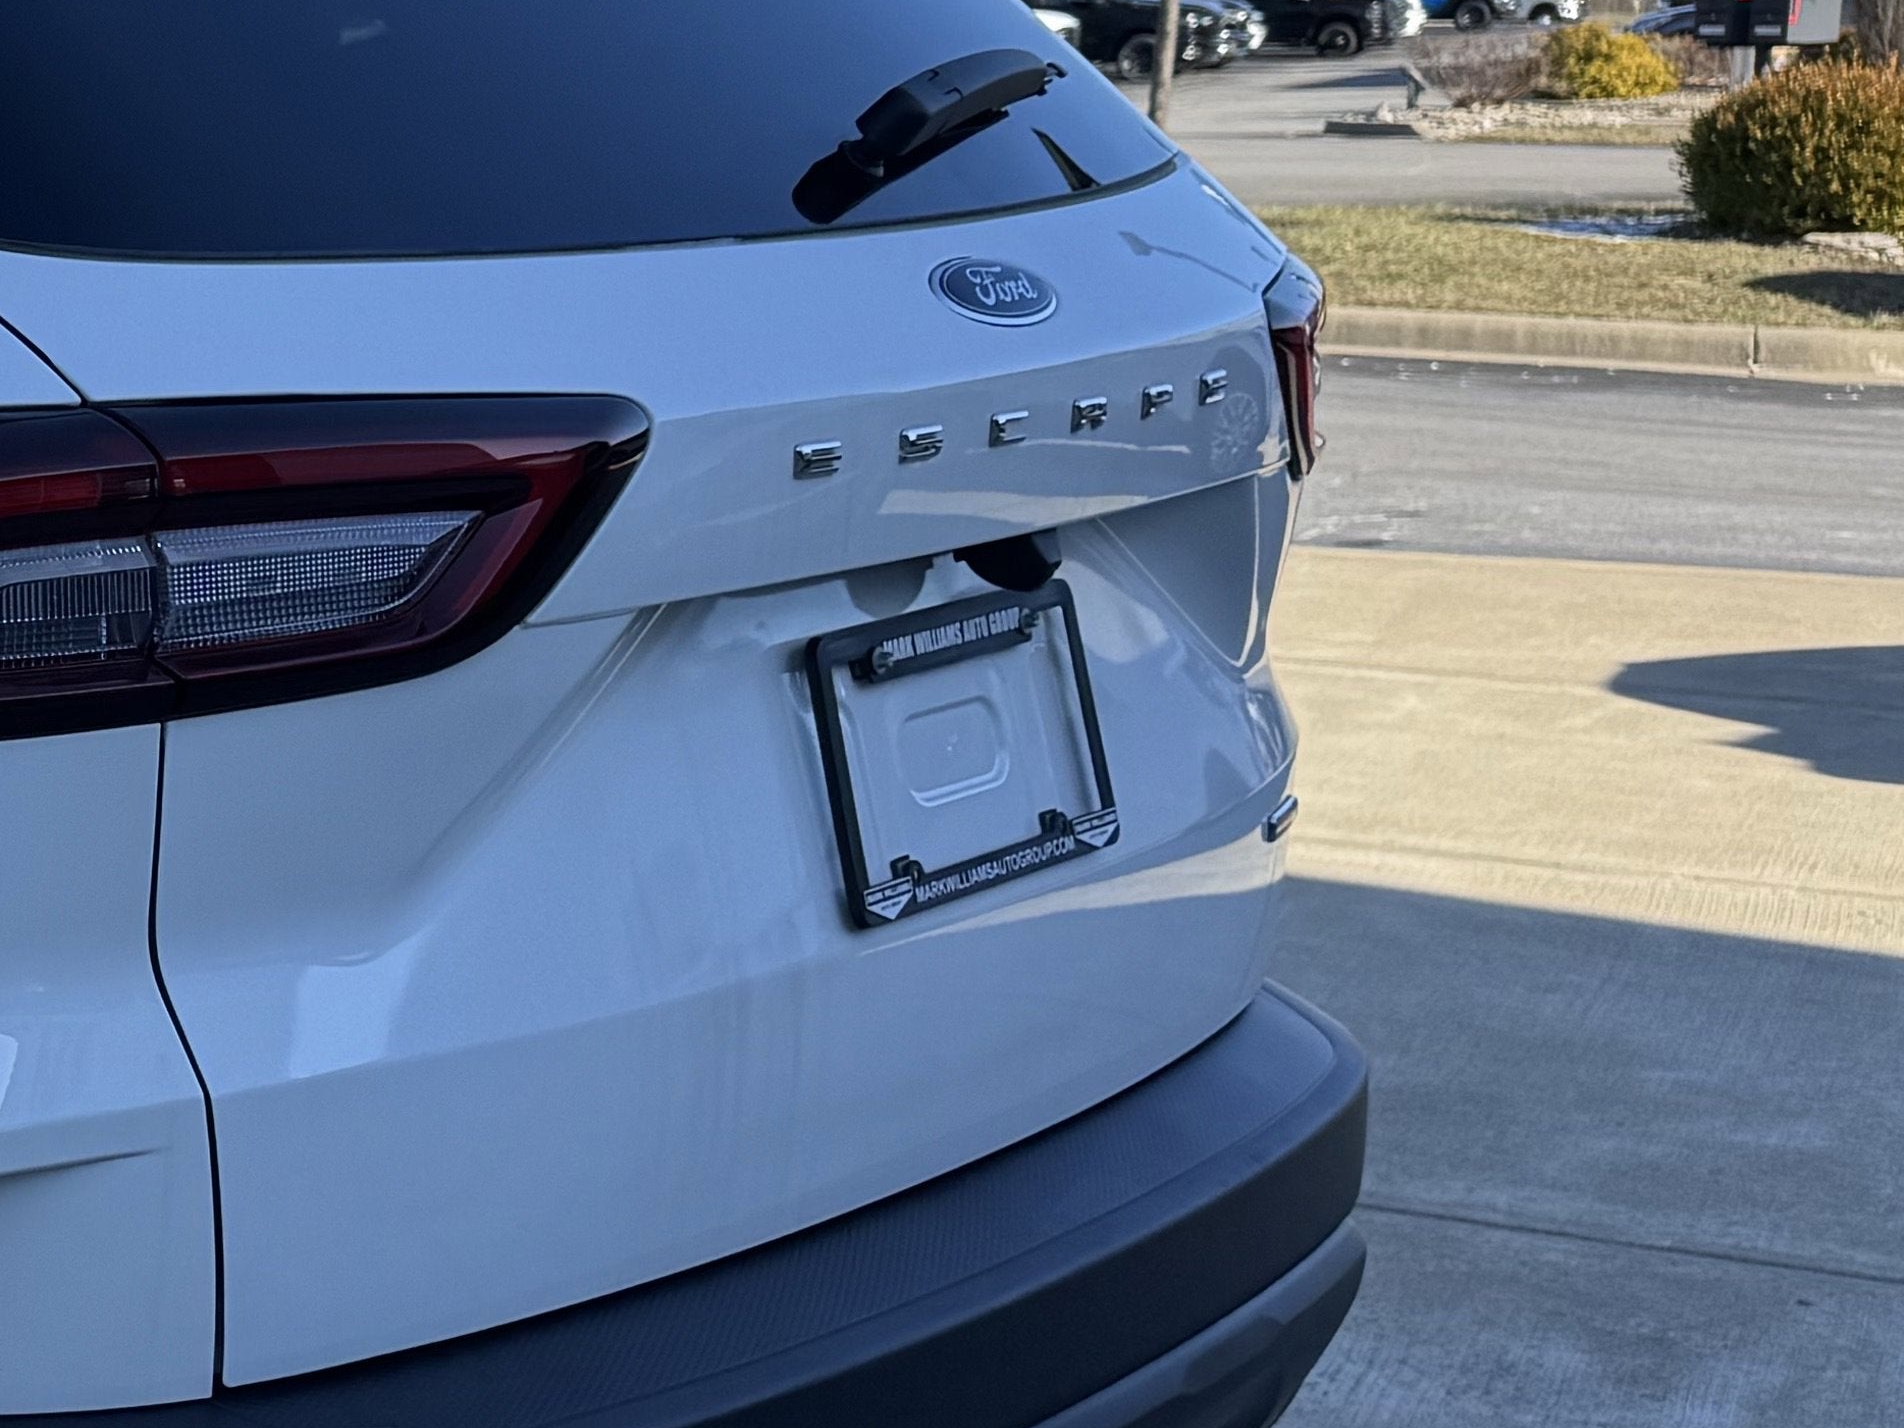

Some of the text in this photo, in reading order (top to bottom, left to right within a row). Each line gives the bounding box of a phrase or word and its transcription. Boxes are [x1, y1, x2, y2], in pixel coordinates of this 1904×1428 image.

[966, 265, 1038, 307] Ford
[793, 368, 1228, 479] ESCAPE
[882, 606, 1020, 662] MARK WILLIAMS AUTO GROUP
